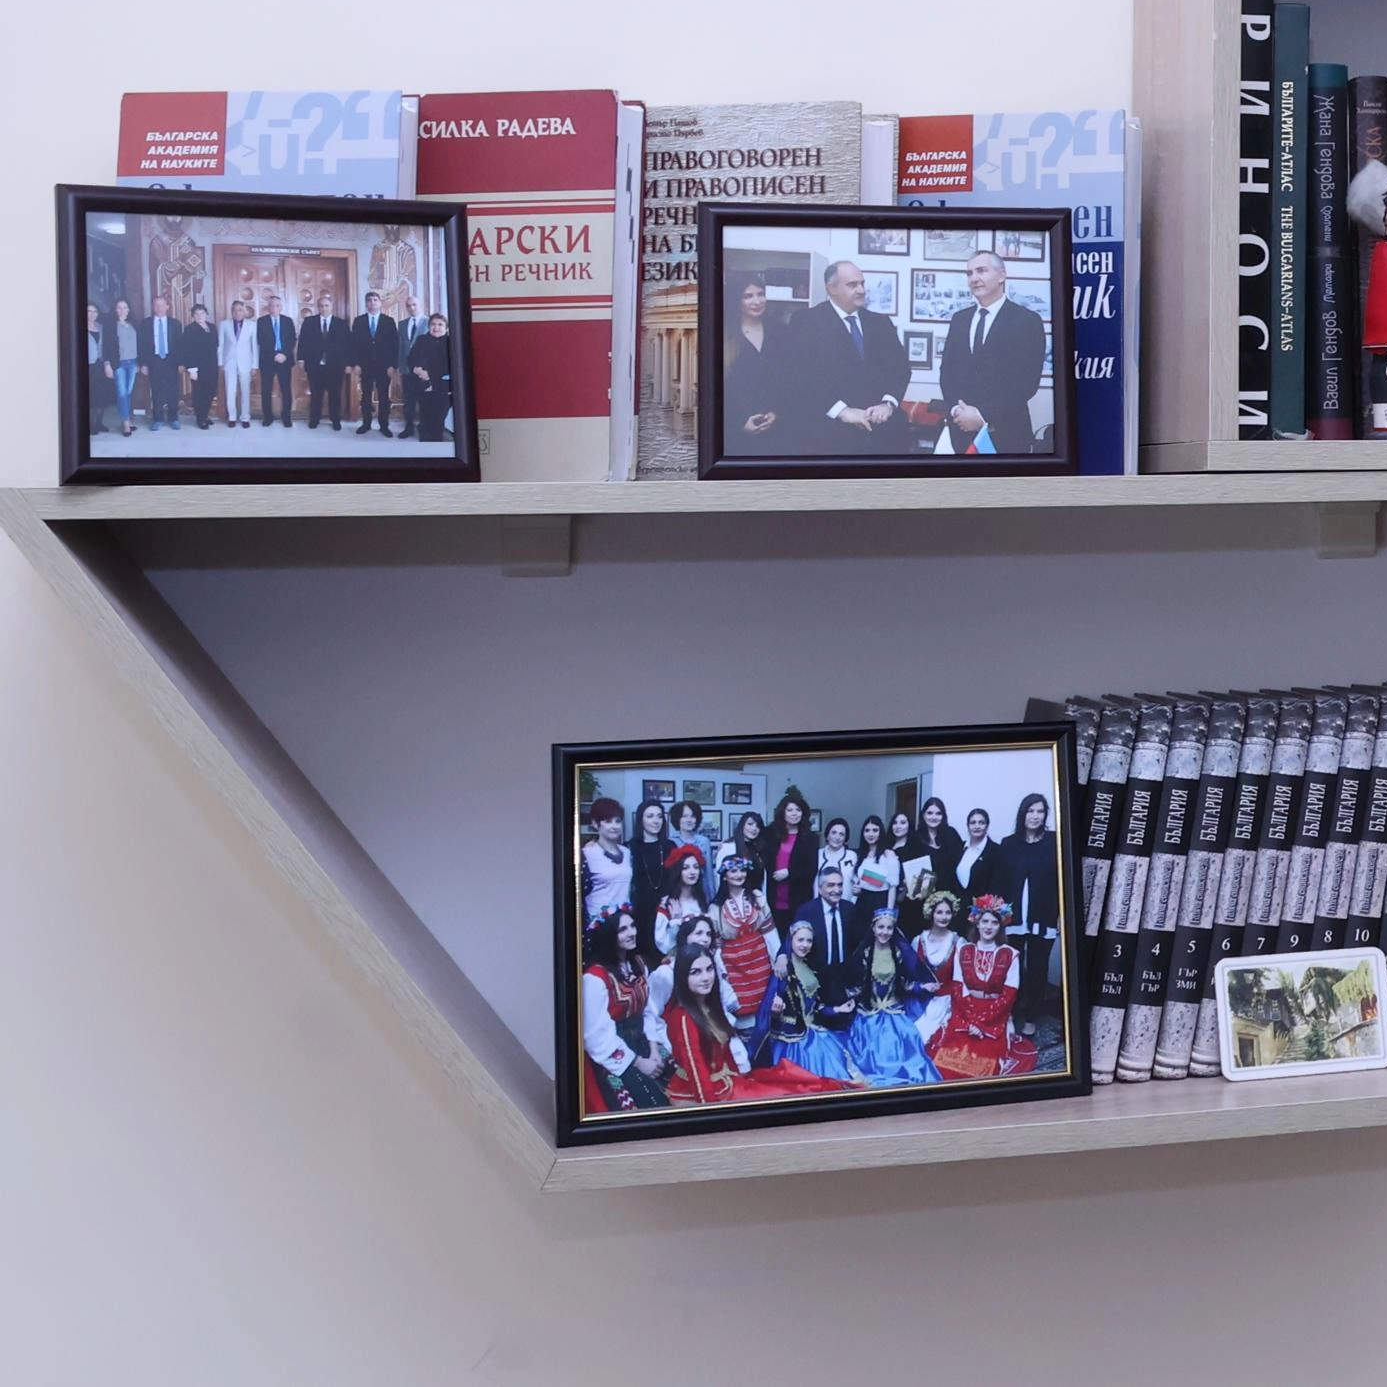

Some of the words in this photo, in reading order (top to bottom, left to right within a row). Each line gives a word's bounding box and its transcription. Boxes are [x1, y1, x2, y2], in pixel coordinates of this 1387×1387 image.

[1313, 94, 1336, 136] Жана
[146, 131, 218, 142] БЪЛГАРСКА
[496, 117, 576, 138] РАДЕВА
[1280, 81, 1294, 192] БЪЛГАРИТЕ-АТЛАС
[147, 145, 218, 156] АКАДЕМИЯ
[645, 147, 822, 171] ПРАВОГОВОРЕН
[905, 150, 967, 162] БЪЛГАРСКА
[140, 160, 158, 169] НА
[161, 159, 217, 169] НАУКИТЕ
[907, 163, 967, 174] АКАДЕМИЯ
[1314, 141, 1337, 199] Гендова
[644, 179, 658, 198] И
[666, 175, 826, 198] ПРАВОПИСЕН
[902, 177, 917, 187] НА
[919, 176, 967, 187] НАУКИТЕ
[1281, 206, 1294, 230] THE
[643, 234, 672, 253] НА
[501, 262, 593, 282] РЕЧНИК
[1280, 232, 1294, 351] BULGARIANS-ATLAS
[1321, 311, 1343, 361] Гендов
[1322, 367, 1340, 410] Васил
[1200, 786, 1223, 842] БЪЛГАРИЯ
[1235, 784, 1259, 840] БЪЛГАРИЯ
[1268, 784, 1292, 840] БЪЛГАРИЯ
[1303, 783, 1327, 838] БЪЛГАРИЯ
[1336, 778, 1359, 833] БЪЛГАРИЯ
[1088, 792, 1113, 848] БЪЛГАРИЯ
[1127, 789, 1151, 846] БЪЛГАРИЯ
[1164, 788, 1188, 844] БЪЛГАРИЯ
[1221, 937, 1231, 950] 6
[1256, 936, 1266, 950] 7
[1290, 934, 1299, 948] 9
[1323, 929, 1333, 942] 8
[1354, 928, 1370, 942] 10
[1112, 944, 1122, 958] 3
[1151, 942, 1161, 955] 4
[1187, 940, 1197, 953] 5
[1103, 971, 1123, 982] БЪЛ
[1142, 970, 1161, 980] БЪЛ
[1175, 979, 1196, 990] ЗМИ
